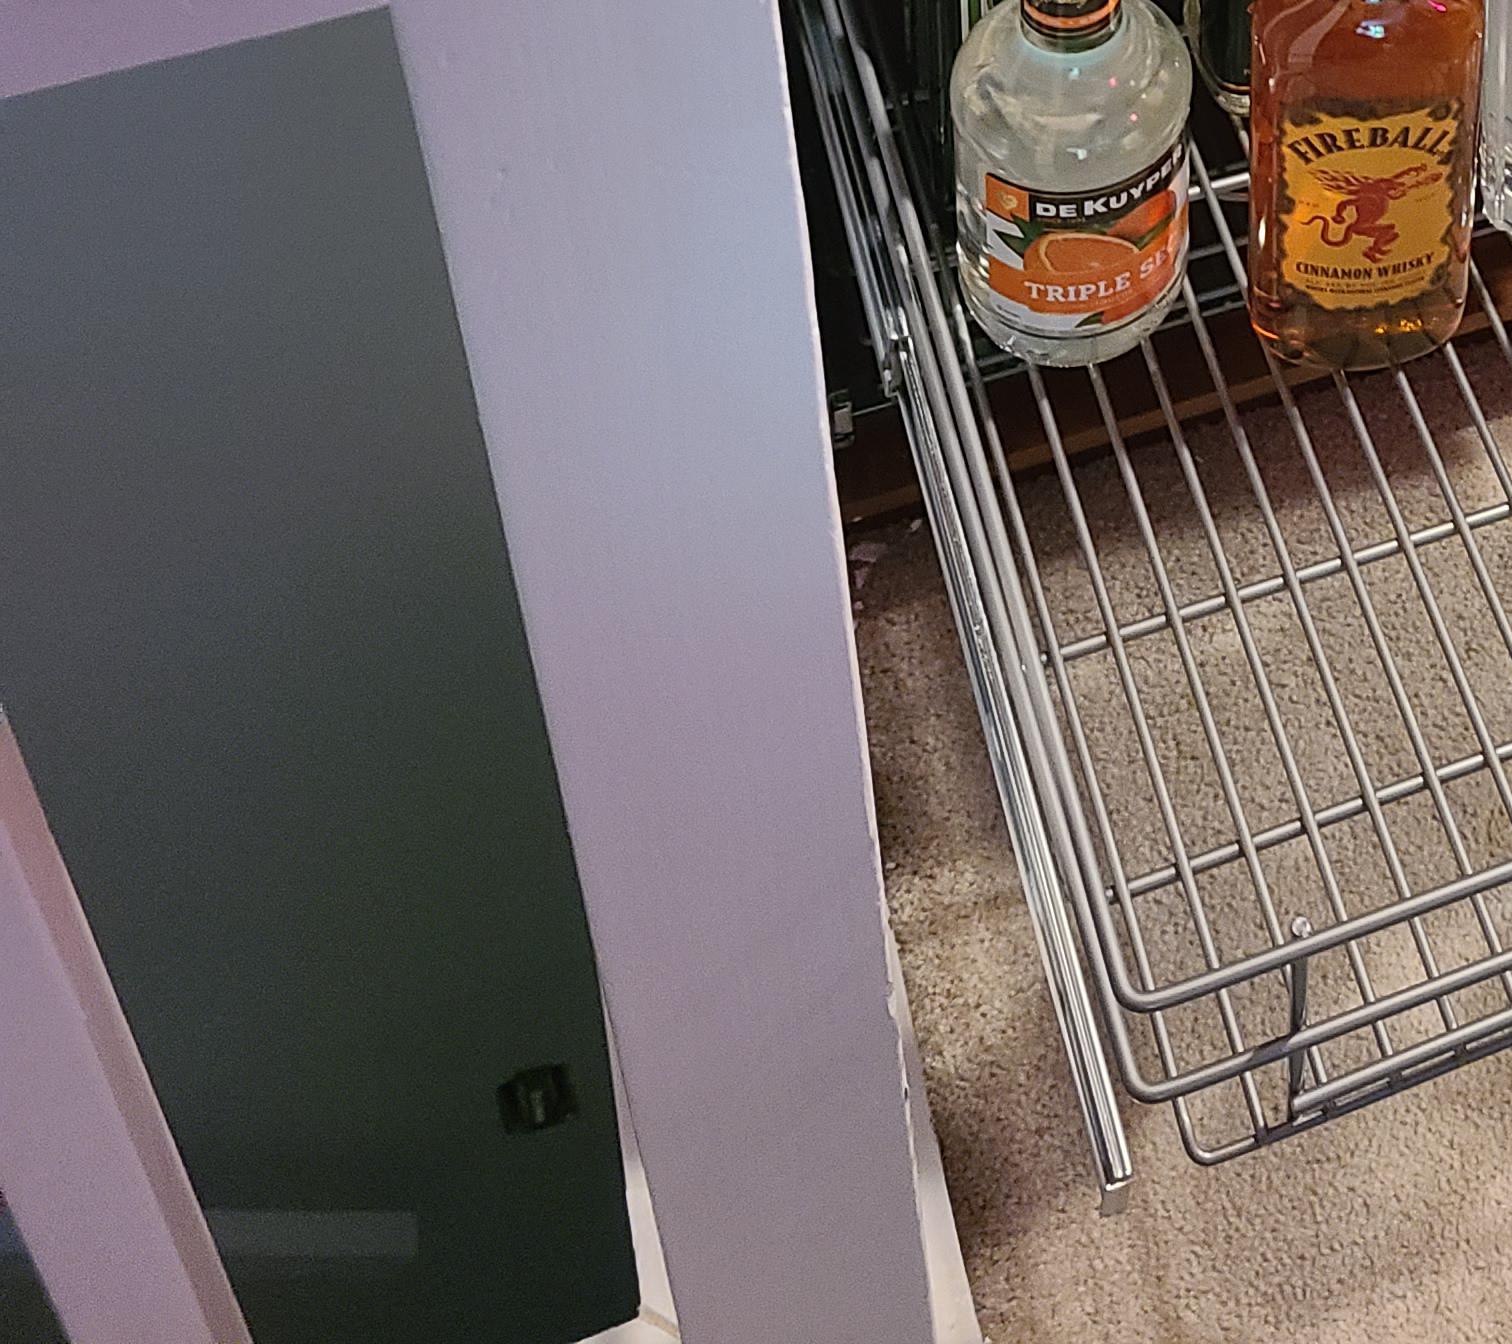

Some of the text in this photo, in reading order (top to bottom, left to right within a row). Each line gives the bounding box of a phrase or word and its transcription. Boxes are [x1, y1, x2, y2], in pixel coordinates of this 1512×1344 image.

[1287, 125, 1455, 166] FIREBALL
[1035, 201, 1078, 219] DE
[1296, 251, 1435, 281] CINNAMON WHISKY
[1023, 271, 1132, 303] TRIPLE
